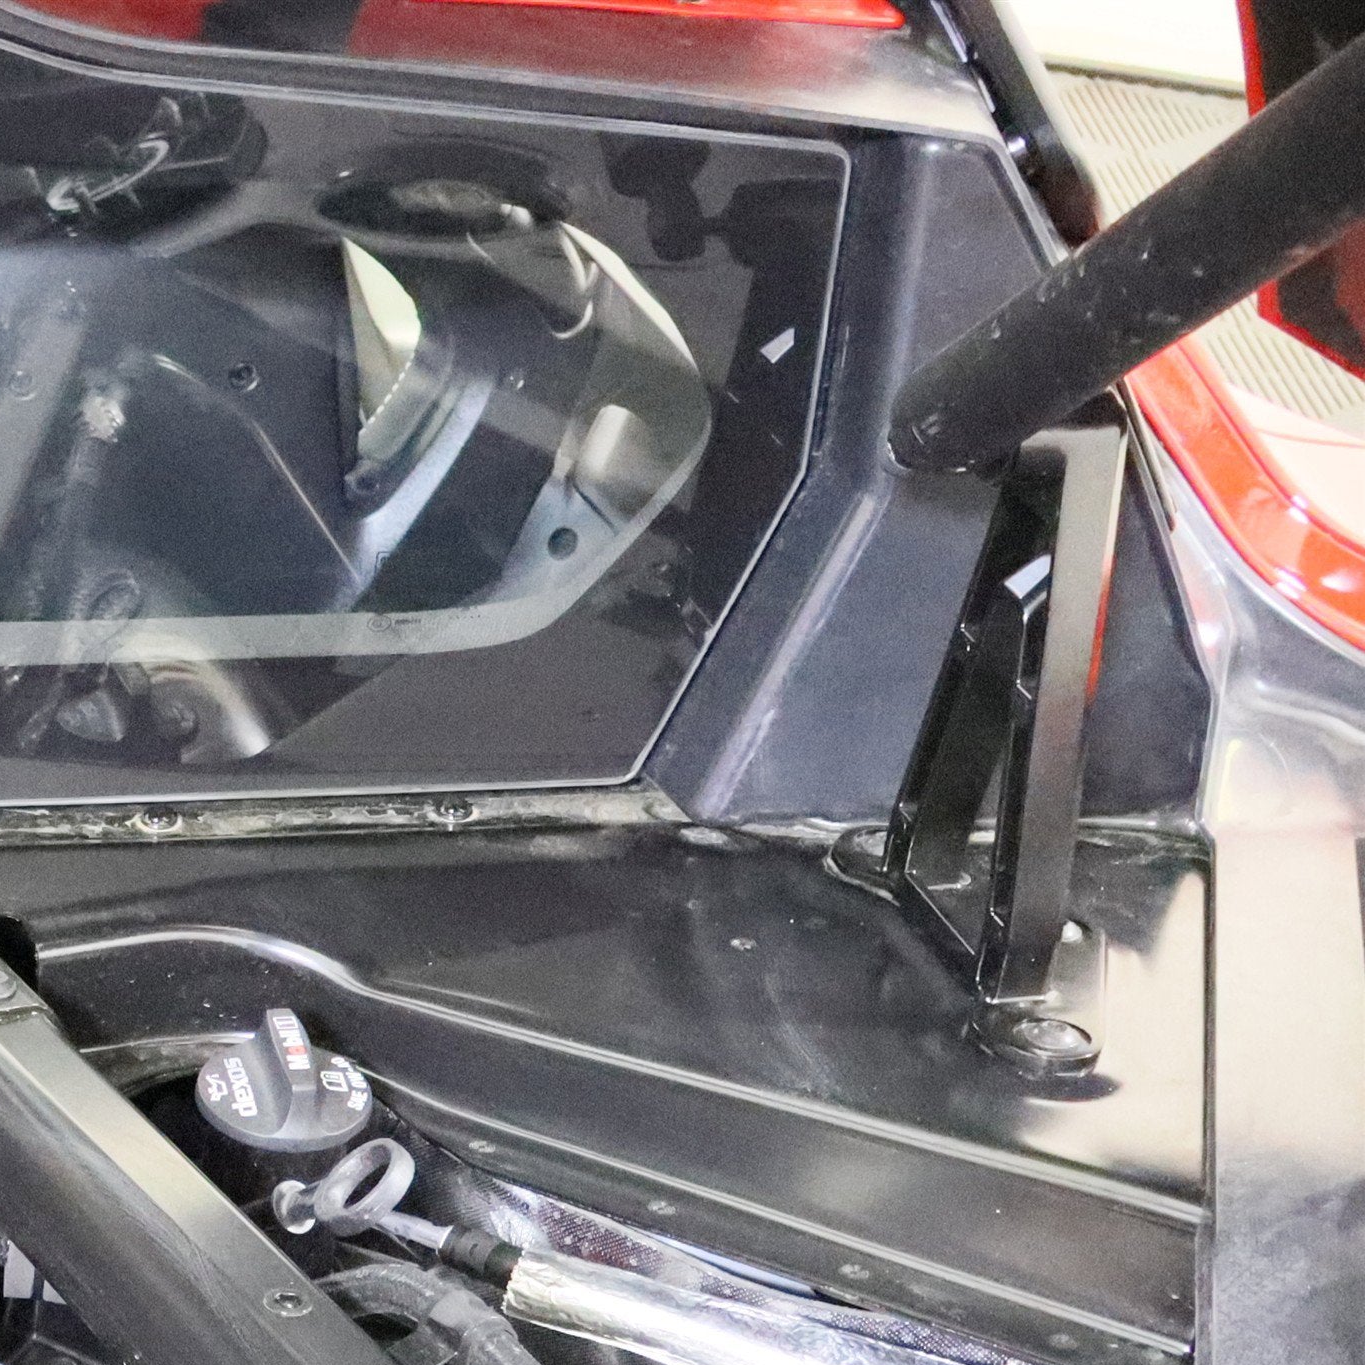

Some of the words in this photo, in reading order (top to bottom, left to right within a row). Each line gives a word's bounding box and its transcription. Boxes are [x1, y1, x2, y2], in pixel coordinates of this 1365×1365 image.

[278, 1029, 311, 1070] Mobil
[223, 1057, 258, 1117] dexos
[347, 1091, 368, 1111] SAE
